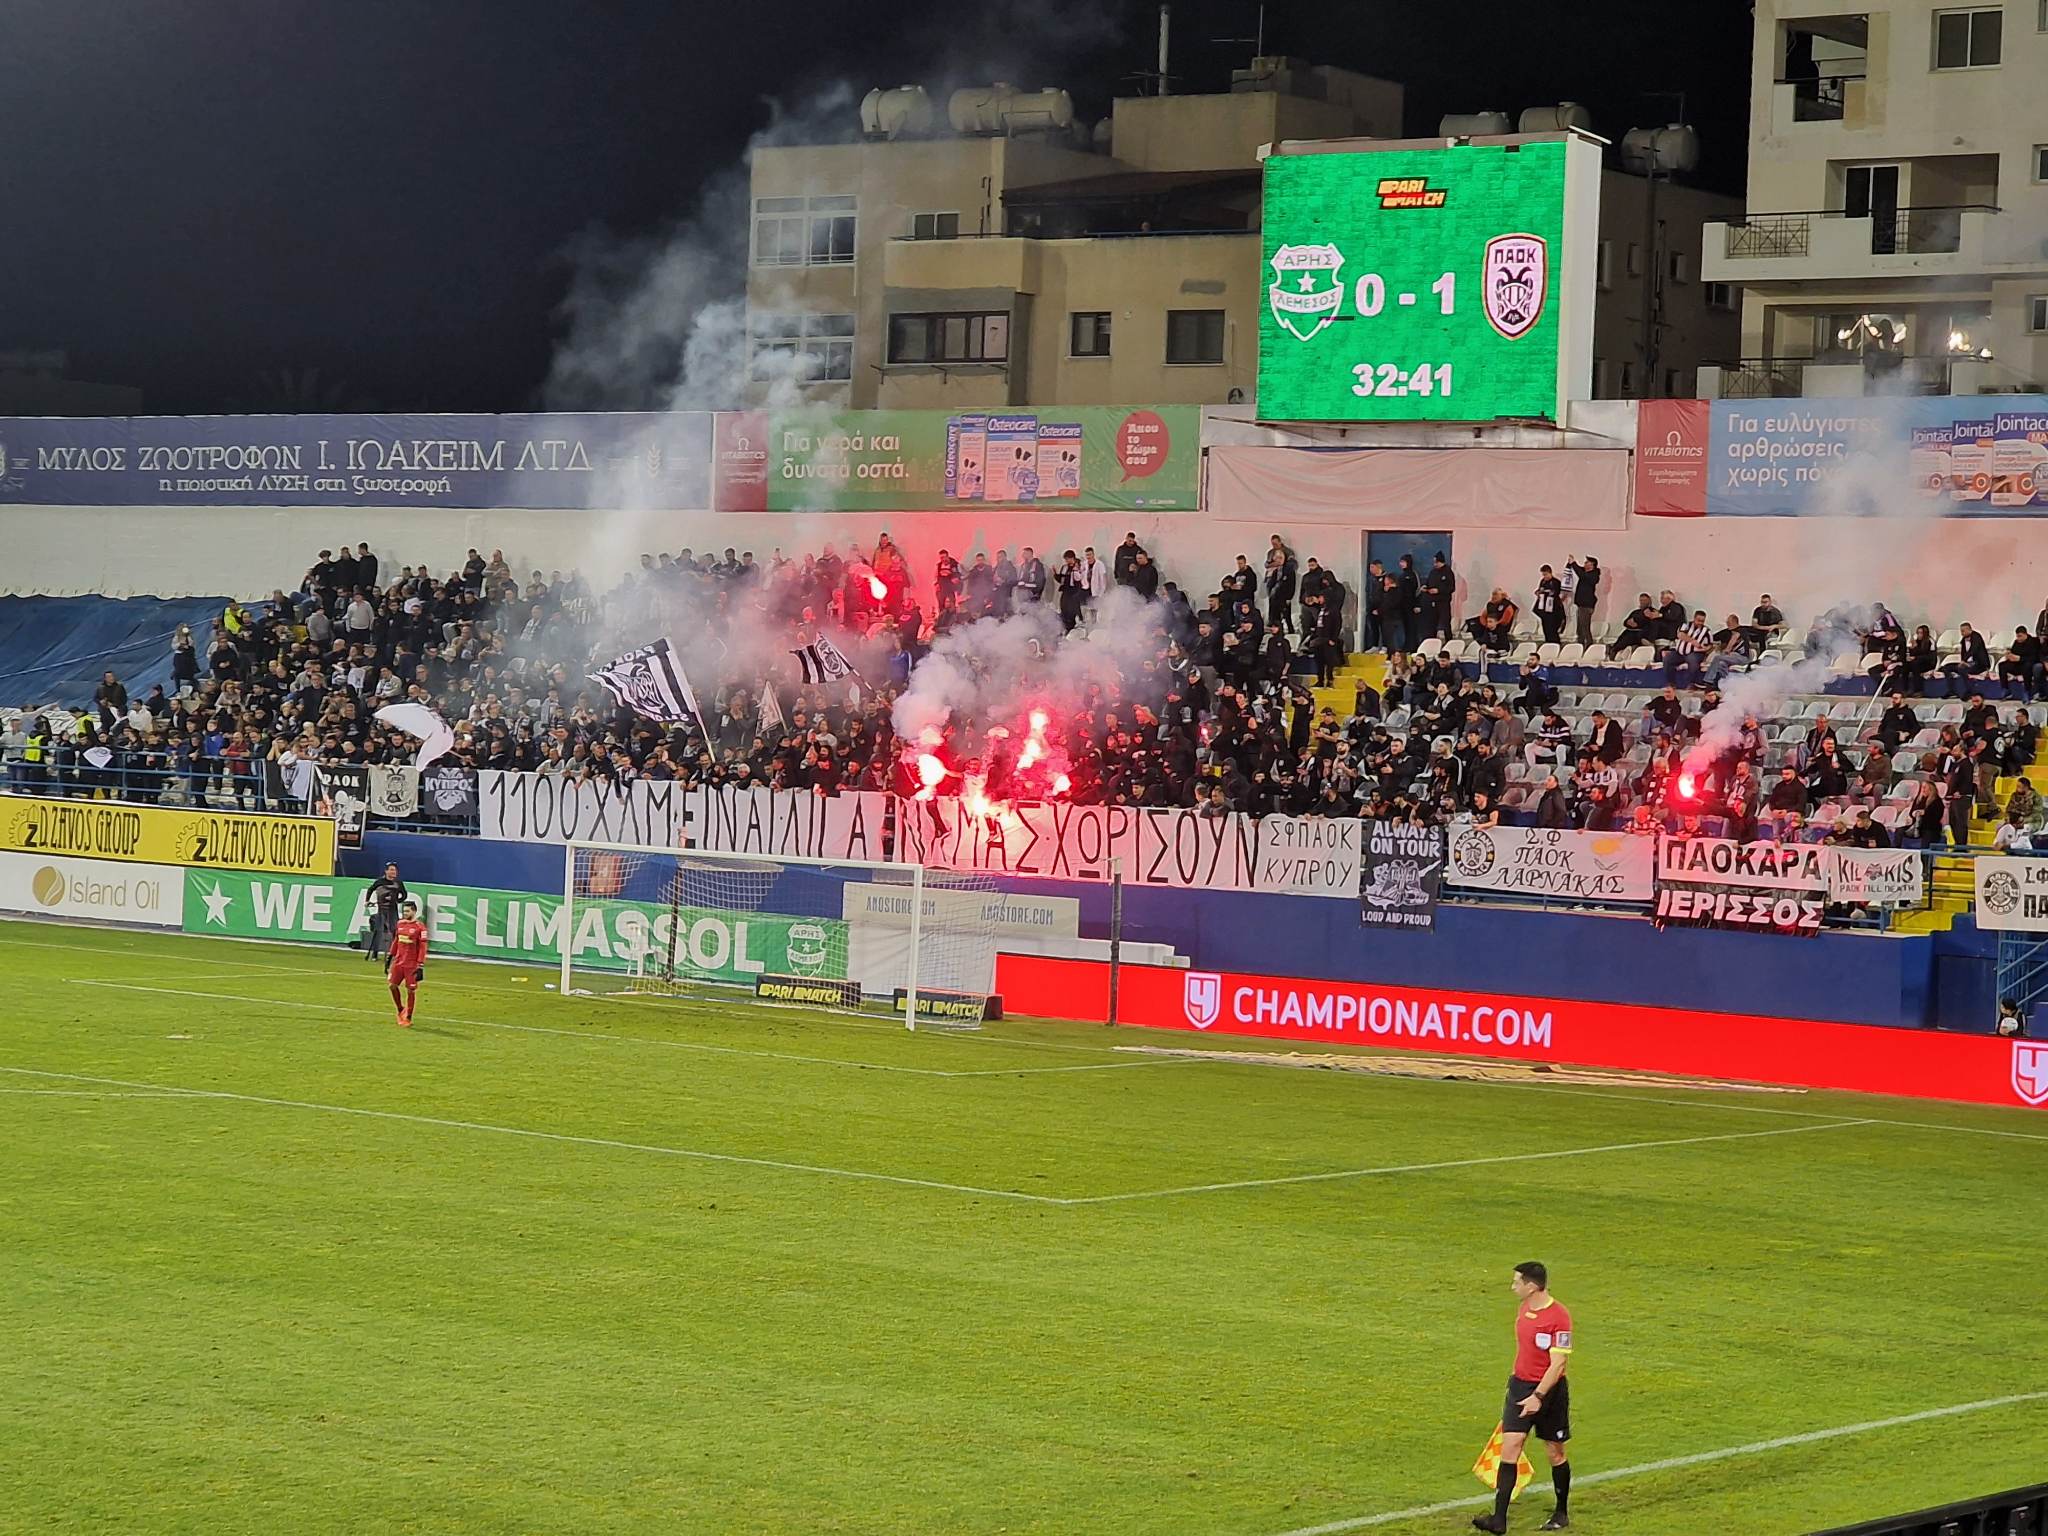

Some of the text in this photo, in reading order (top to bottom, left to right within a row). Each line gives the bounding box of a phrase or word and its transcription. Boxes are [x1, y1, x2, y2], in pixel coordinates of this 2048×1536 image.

[1283, 253, 1333, 267] ΑΡΗΣ
[1494, 248, 1536, 264] ΠΑΟΚ
[1355, 273, 1386, 317] 0
[1431, 271, 1455, 315] 1
[1351, 363, 1453, 397] 32:41
[987, 418, 1036, 431] Osteocare
[1039, 425, 1081, 437] Osteocare
[1728, 414, 1758, 433] Για
[37, 447, 126, 471] ΜΥΛΟΣ
[137, 445, 303, 471] ΖΩΟΤΡΟΦΩΝ
[317, 440, 336, 471] Ι.
[346, 440, 507, 471] ΙΩΑΚΕΙΜ
[513, 440, 595, 471] ΛΤΔ
[870, 435, 900, 451] και
[1643, 446, 1704, 457] VITABIOTICS
[257, 474, 309, 491] ΛΥΣΗ
[1727, 461, 1788, 487] χωρίς
[51, 807, 92, 851] ZAVOS
[95, 810, 141, 855] GROUP
[221, 819, 266, 865] ZAVOS
[269, 822, 317, 868] GROUP
[1370, 838, 1441, 857] ON TOUR
[1514, 846, 1576, 872] ΠΑΟΚ
[1666, 839, 1823, 881] ΠΑΟΚΑΡΑ
[1263, 857, 1354, 888] ΚΥΠΡΟΥ
[1491, 867, 1625, 897] ΛΑΡΝΑΚΑΣ
[69, 874, 160, 910] Island Oil
[1362, 910, 1432, 926] LOUD AND PROUD
[1656, 889, 1825, 929] ΙΕΡΙΣΣΟΣ
[250, 881, 334, 932] WE
[475, 898, 766, 974] LIMASSOL
[1233, 986, 1553, 1048] CHAMPIONAT.COM
